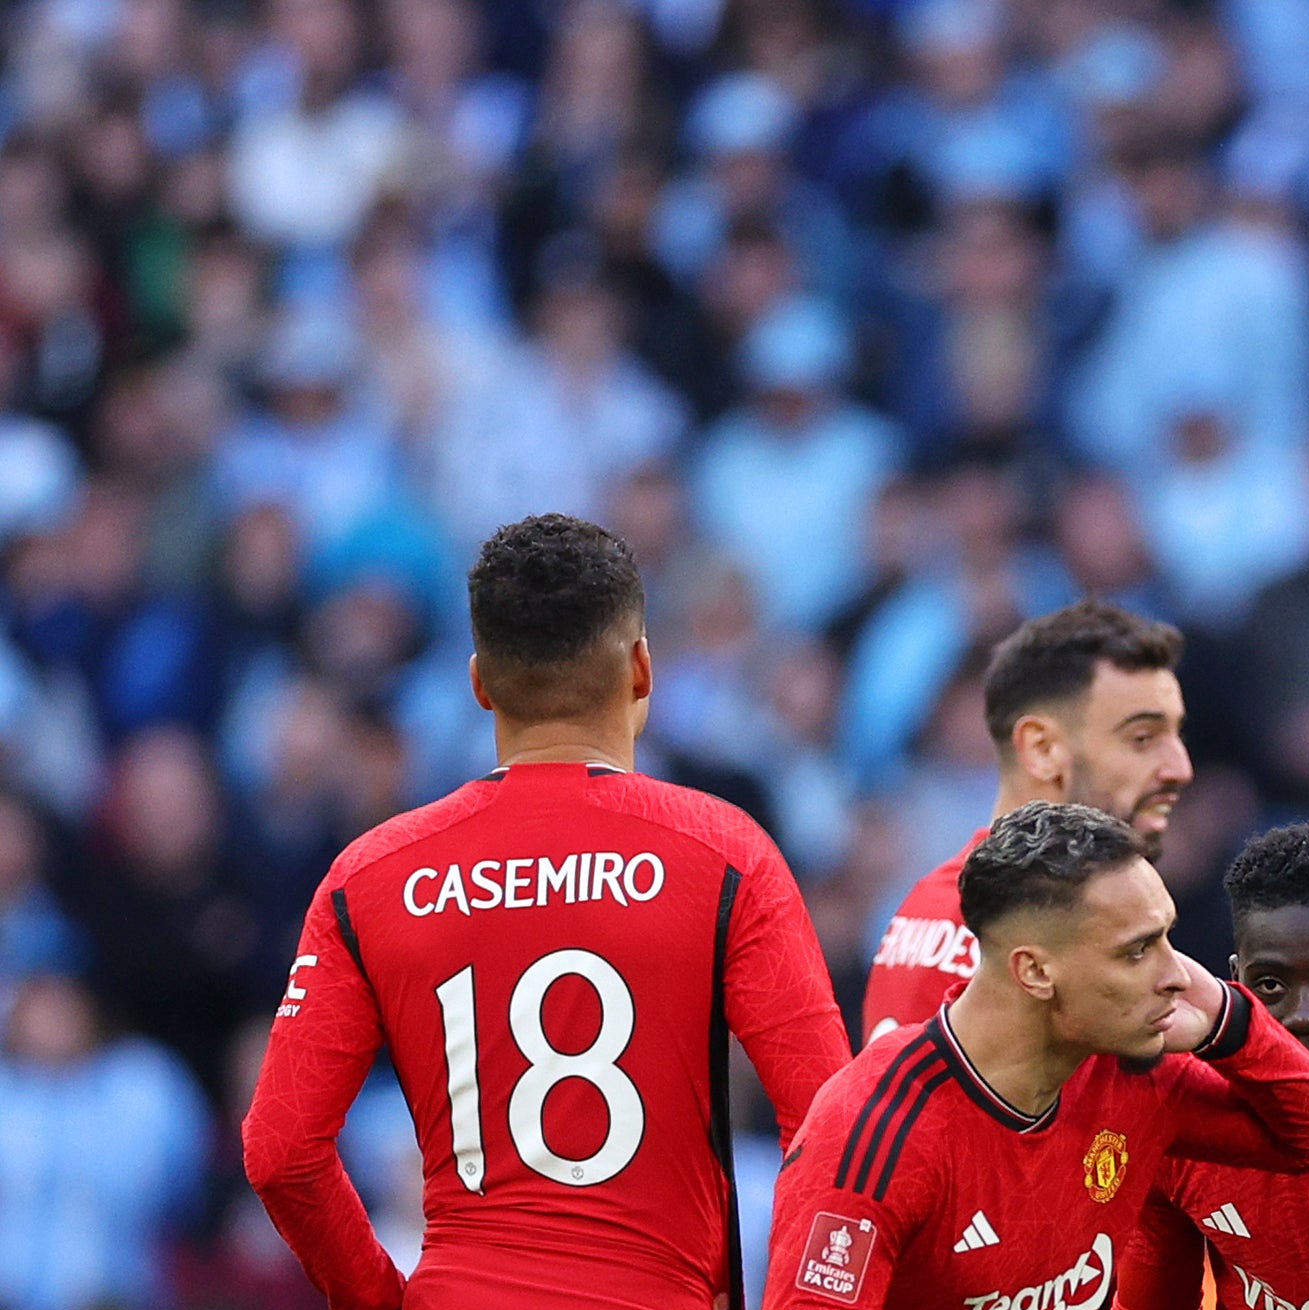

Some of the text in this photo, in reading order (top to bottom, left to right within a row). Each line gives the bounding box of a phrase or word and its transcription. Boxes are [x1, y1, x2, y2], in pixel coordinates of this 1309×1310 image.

[402, 852, 666, 916] CASEMIRO
[434, 947, 646, 1197] 18
[804, 1270, 853, 1294] FA CUP
[807, 1259, 855, 1283] Emirates
